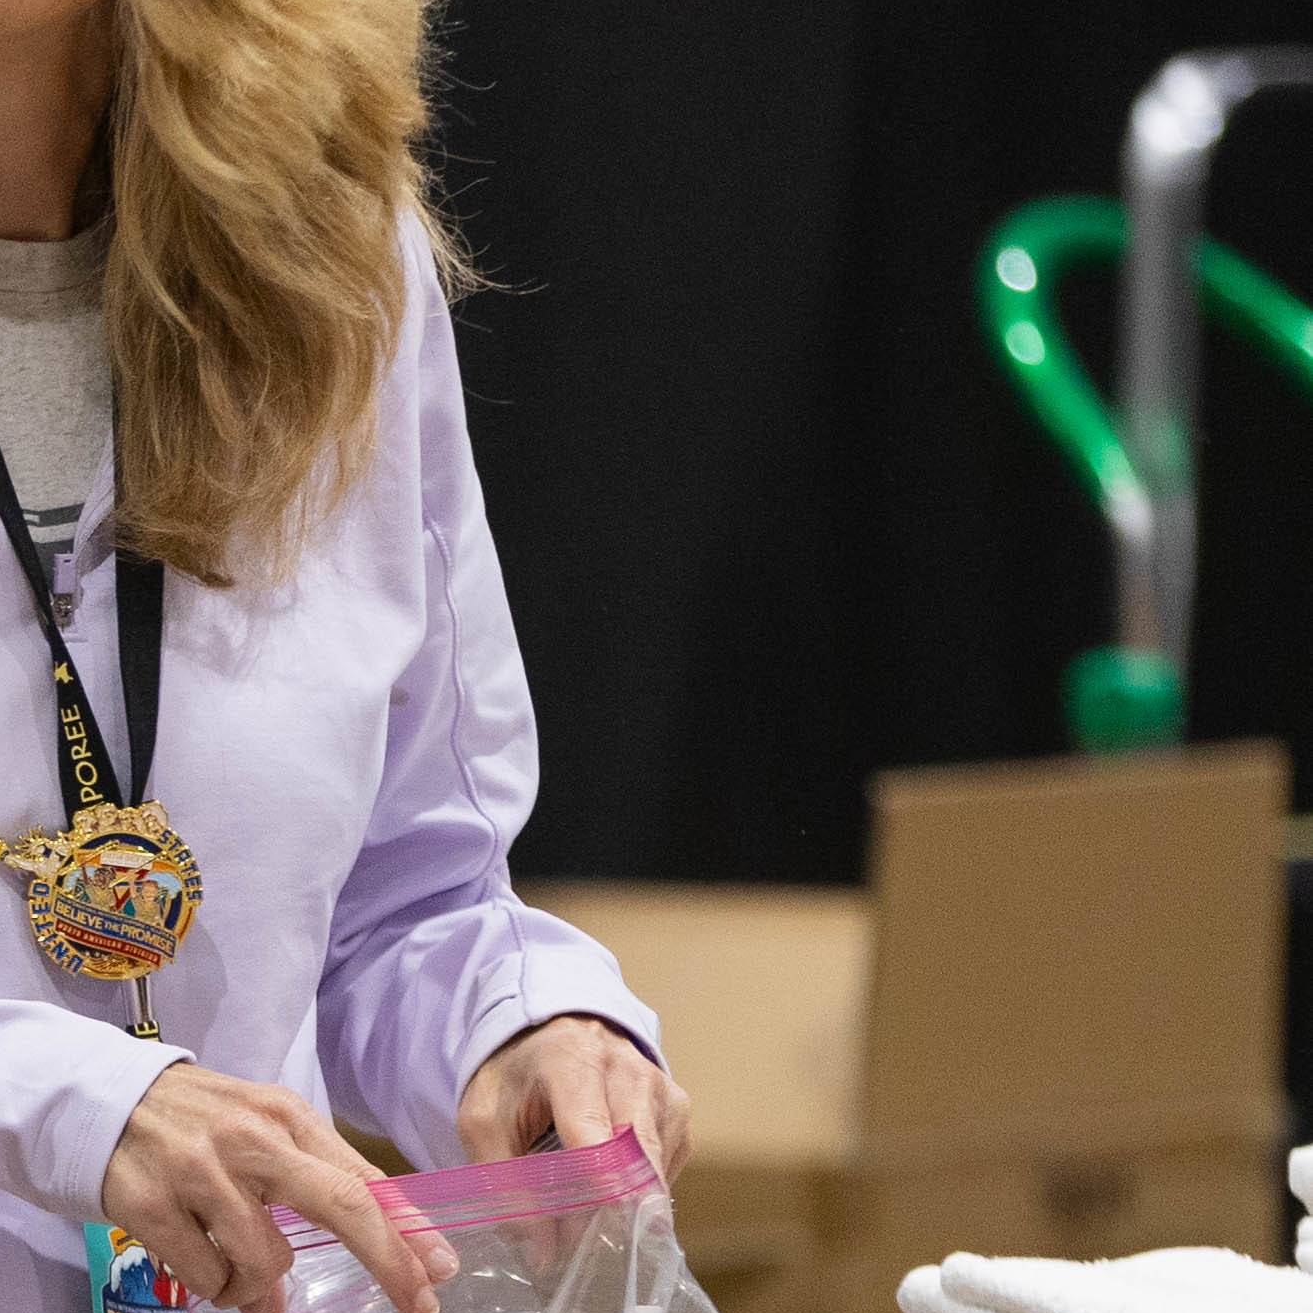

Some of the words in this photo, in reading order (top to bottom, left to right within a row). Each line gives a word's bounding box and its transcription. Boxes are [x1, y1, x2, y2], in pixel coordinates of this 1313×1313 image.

[61, 704, 104, 806] POREE
[158, 829, 203, 901] STATES
[32, 882, 84, 973] UNITED
[56, 899, 105, 928] BELIEVE
[105, 922, 120, 933] THE
[119, 922, 174, 953] PROMISE
